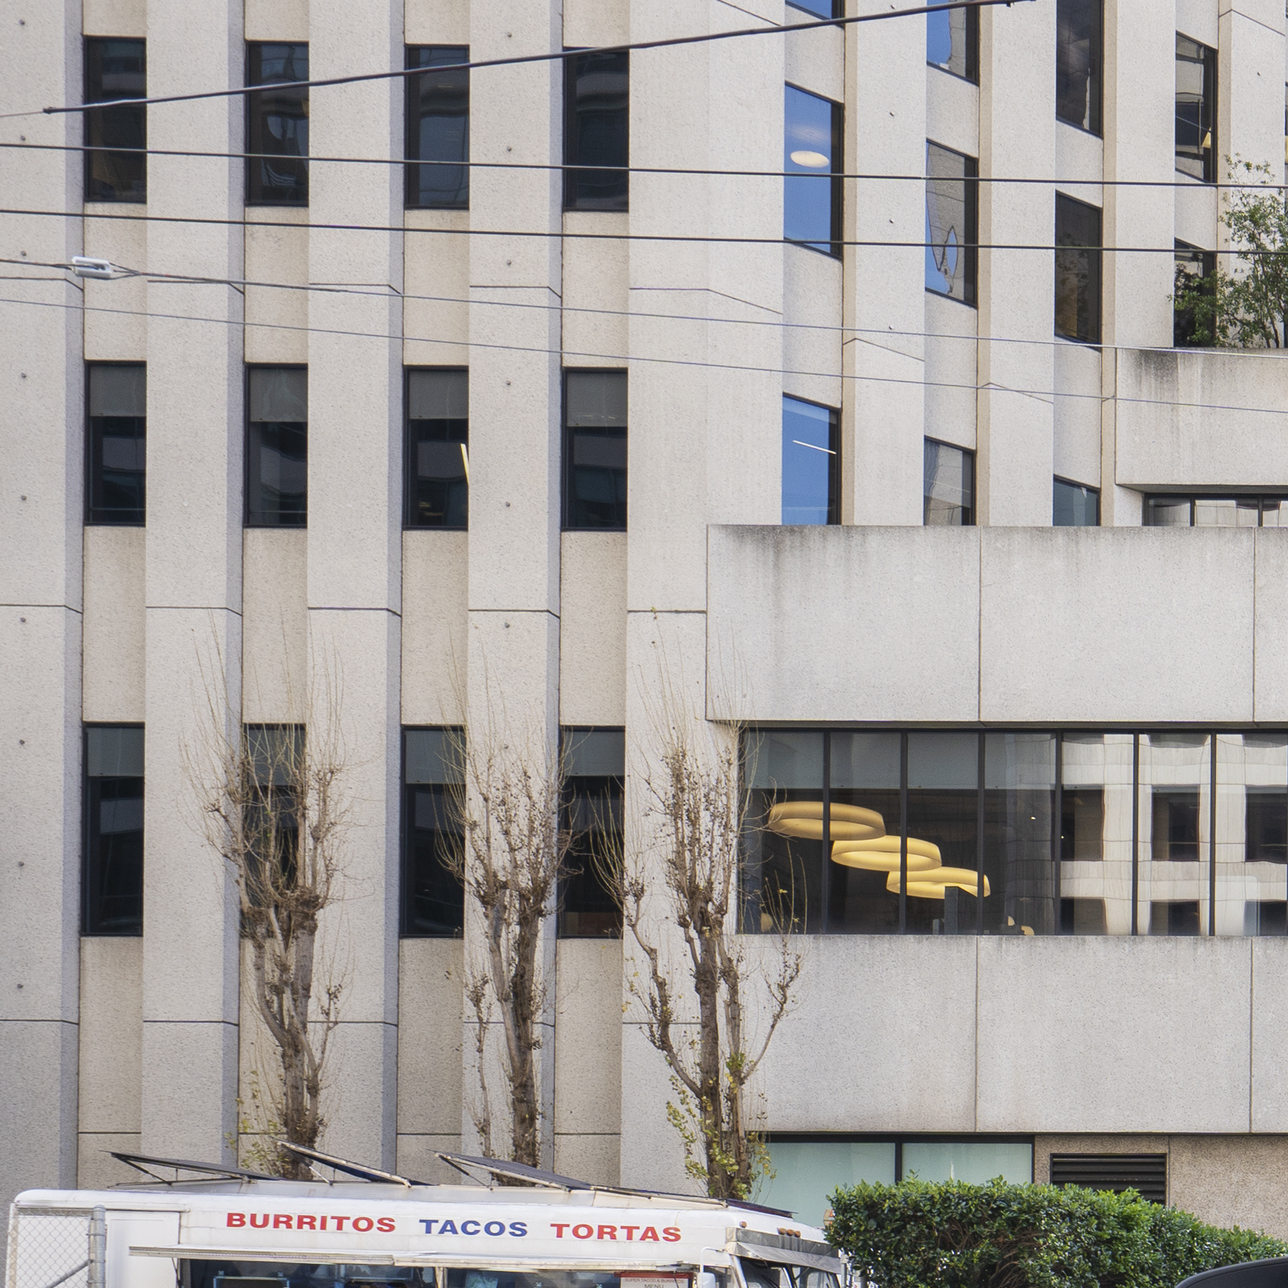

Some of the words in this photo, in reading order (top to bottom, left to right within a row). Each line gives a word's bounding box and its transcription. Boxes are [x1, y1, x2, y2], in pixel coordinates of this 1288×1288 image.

[226, 1212, 396, 1233] BURRITOS
[419, 1219, 528, 1238] TACOS
[550, 1223, 682, 1242] TORTAS
